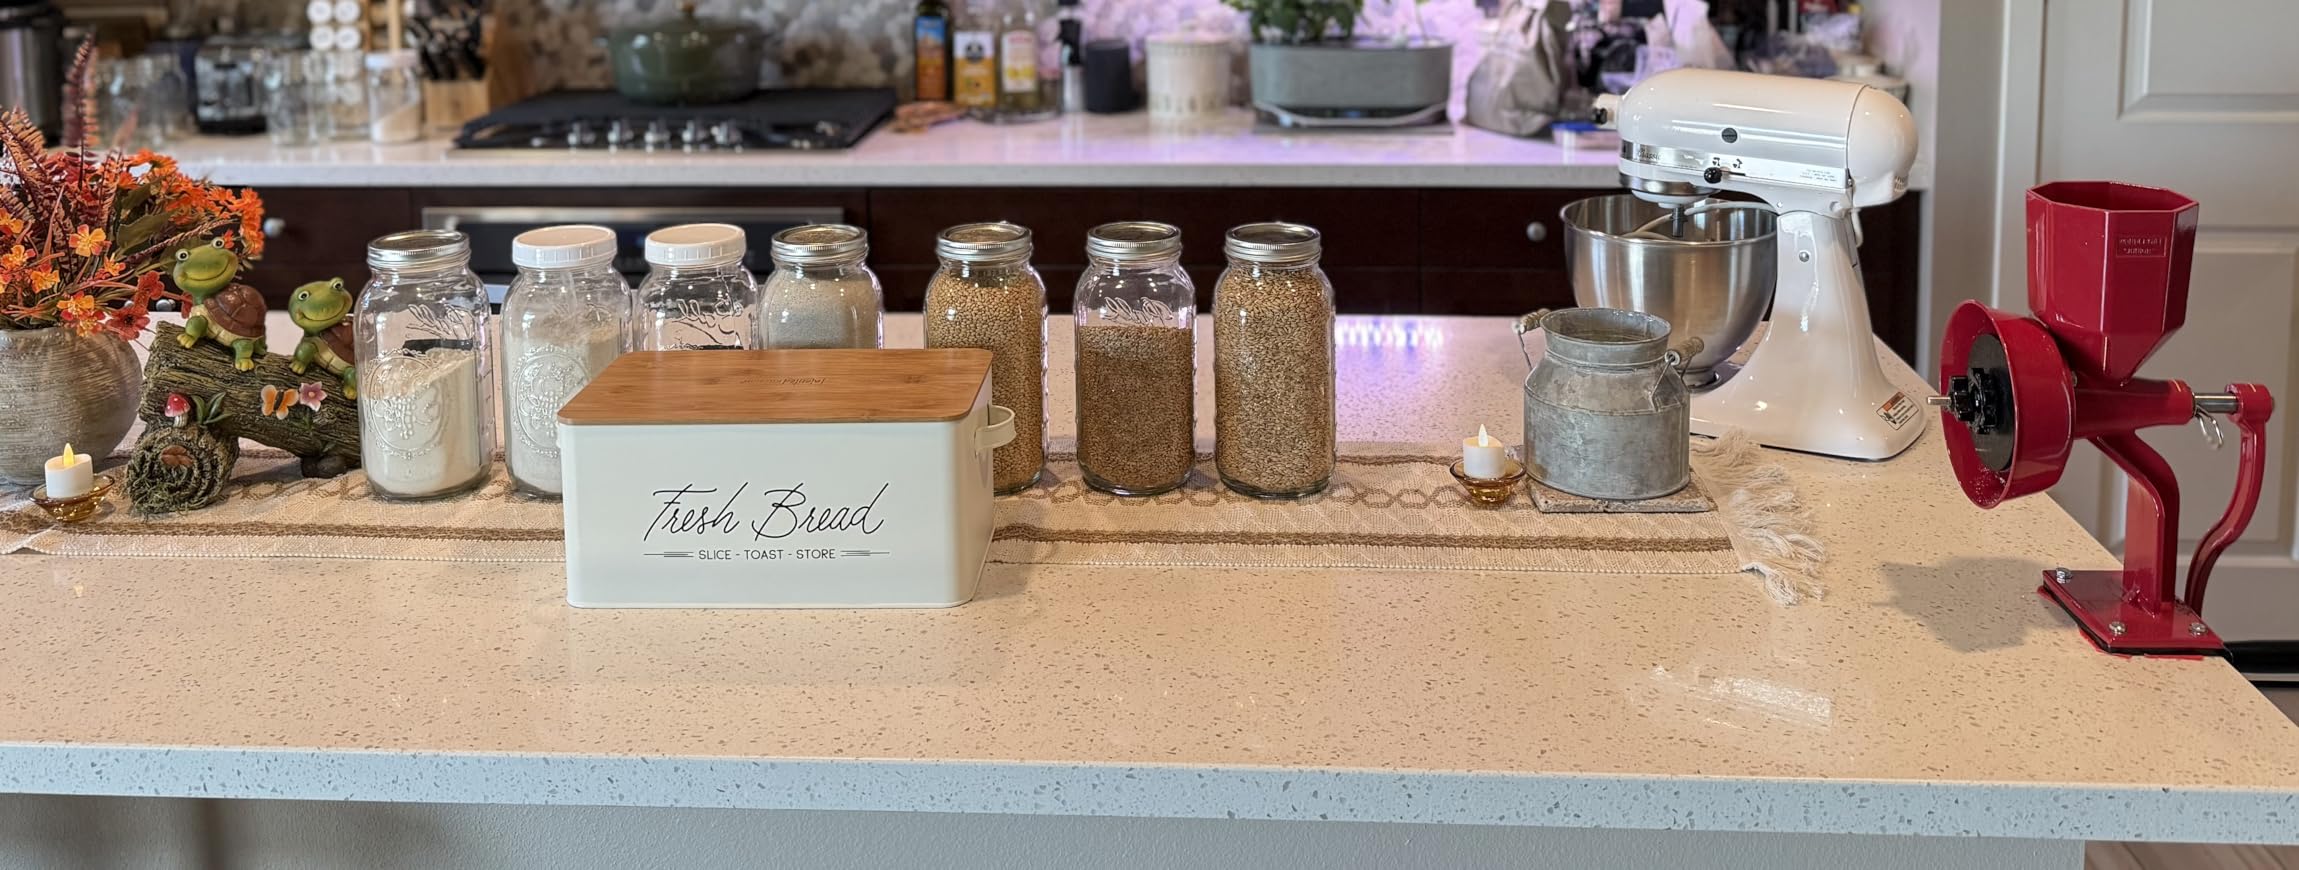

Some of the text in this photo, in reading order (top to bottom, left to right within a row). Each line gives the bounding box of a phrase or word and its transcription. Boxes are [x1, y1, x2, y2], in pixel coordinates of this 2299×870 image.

[643, 481, 889, 542] Fresh Bread
[698, 549, 732, 560] SLICE
[743, 549, 784, 560] TOAST
[796, 548, 836, 560] STORE
